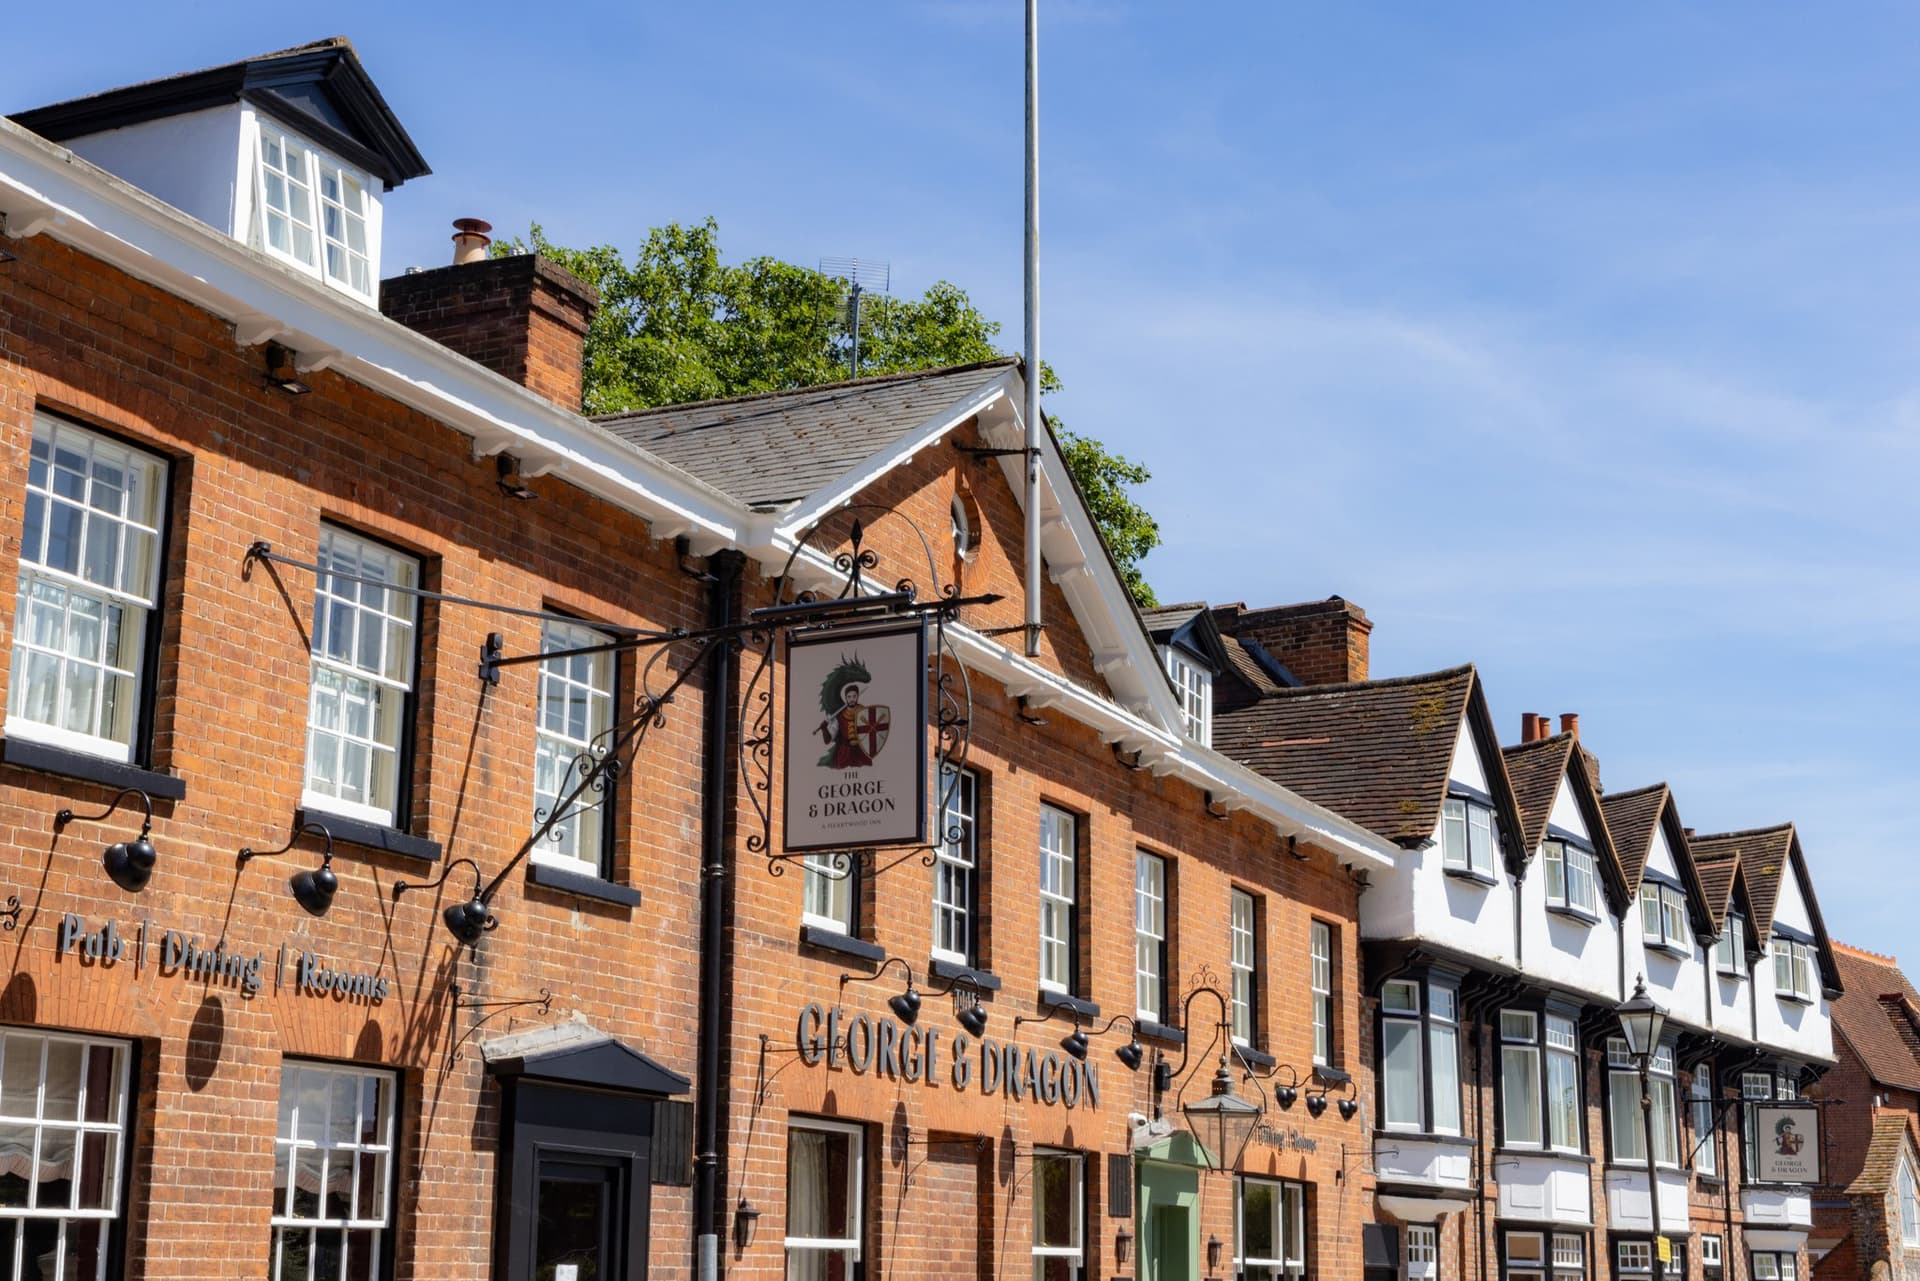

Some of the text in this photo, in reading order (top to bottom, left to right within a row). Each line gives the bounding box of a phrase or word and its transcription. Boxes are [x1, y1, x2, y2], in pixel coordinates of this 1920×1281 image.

[808, 797, 896, 818] & DRAGON
[818, 780, 886, 799] GEORGE
[62, 913, 125, 960] Pub
[165, 930, 264, 990] Dining
[301, 951, 390, 999] Rooms
[800, 1002, 1100, 1109] GEORGE & DRAGON
